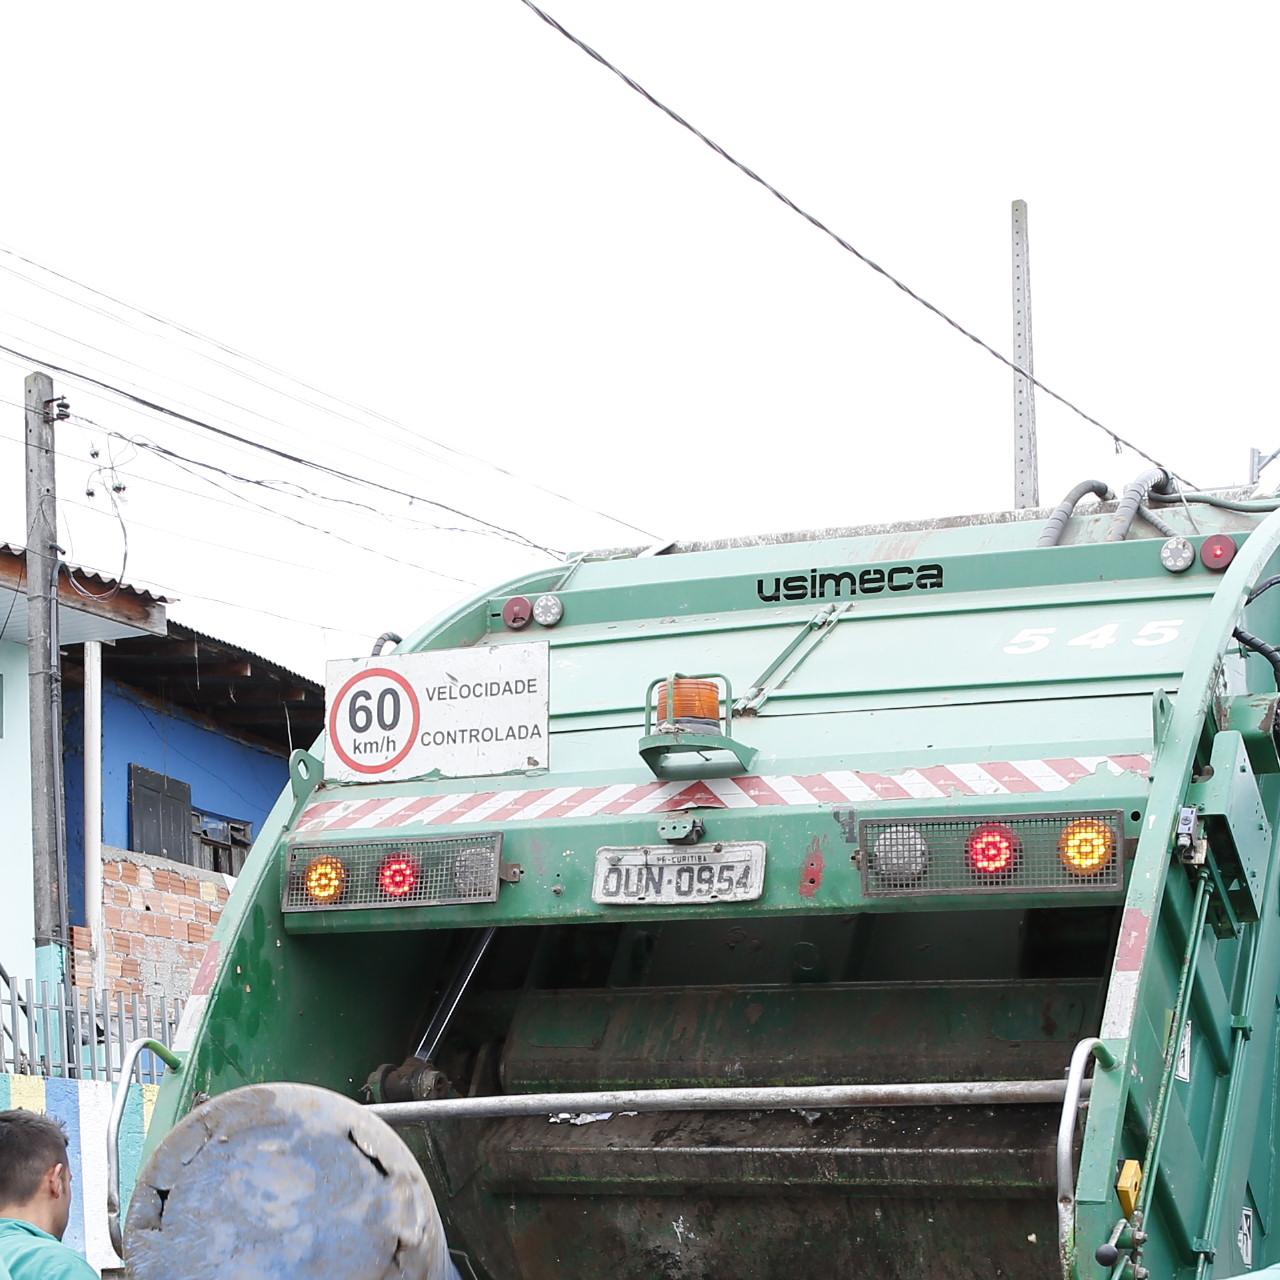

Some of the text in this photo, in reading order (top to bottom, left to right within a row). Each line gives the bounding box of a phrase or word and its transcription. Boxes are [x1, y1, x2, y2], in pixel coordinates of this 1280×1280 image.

[757, 563, 944, 602] usimeca
[1002, 618, 1185, 655] 545
[426, 678, 538, 702] VELOCIDADE
[348, 687, 401, 733] 60
[352, 735, 397, 755] km/h
[420, 724, 542, 747] CONTROLADA
